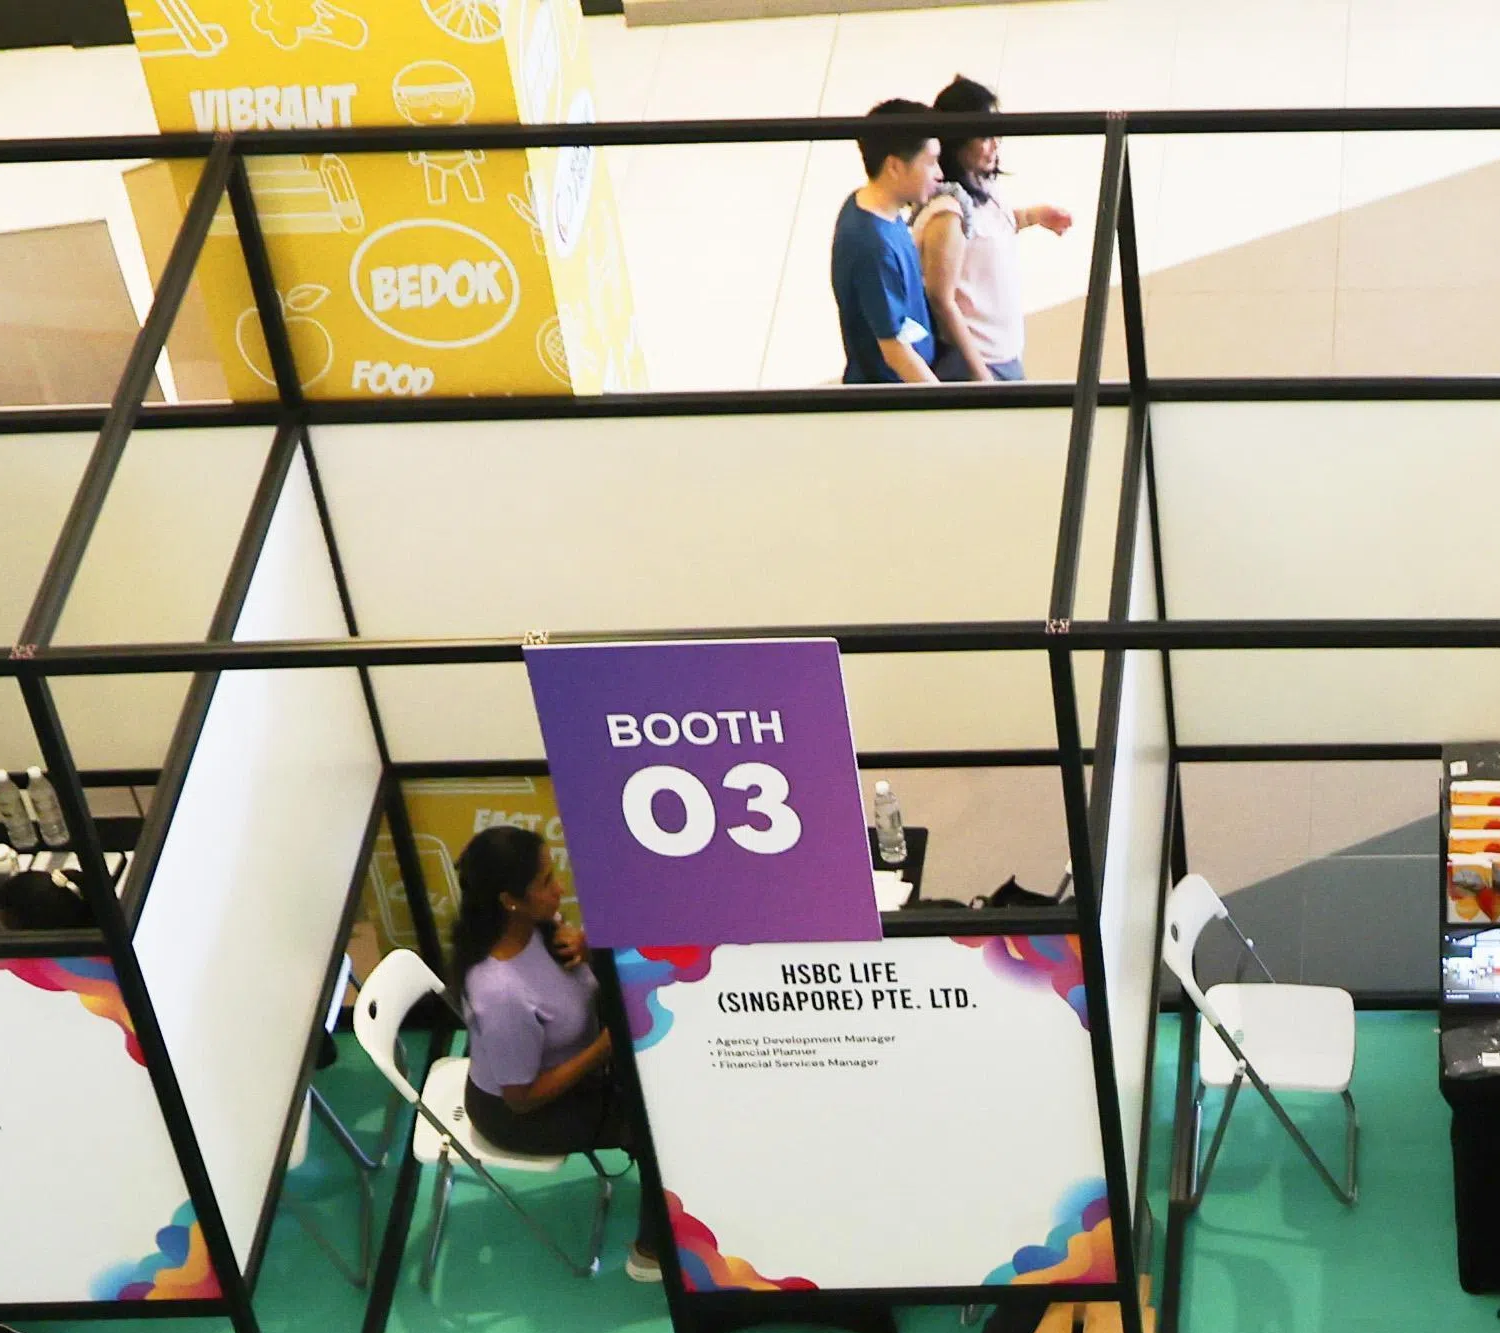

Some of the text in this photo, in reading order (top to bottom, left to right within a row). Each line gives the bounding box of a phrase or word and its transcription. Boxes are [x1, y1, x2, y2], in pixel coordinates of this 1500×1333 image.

[190, 83, 358, 131] VIBRANT
[370, 260, 506, 312] BEDOK
[351, 360, 434, 396] FOOD
[605, 710, 785, 748] BOOTH
[622, 762, 802, 857] 03
[781, 962, 898, 984] HSBC LIFE
[718, 988, 977, 1013] (SINGAPORE) PTE. LTD.
[715, 1035, 895, 1047] Agency Development Manager
[717, 1048, 817, 1057] Financial Planner
[720, 1058, 878, 1068] Financial Services Manager
